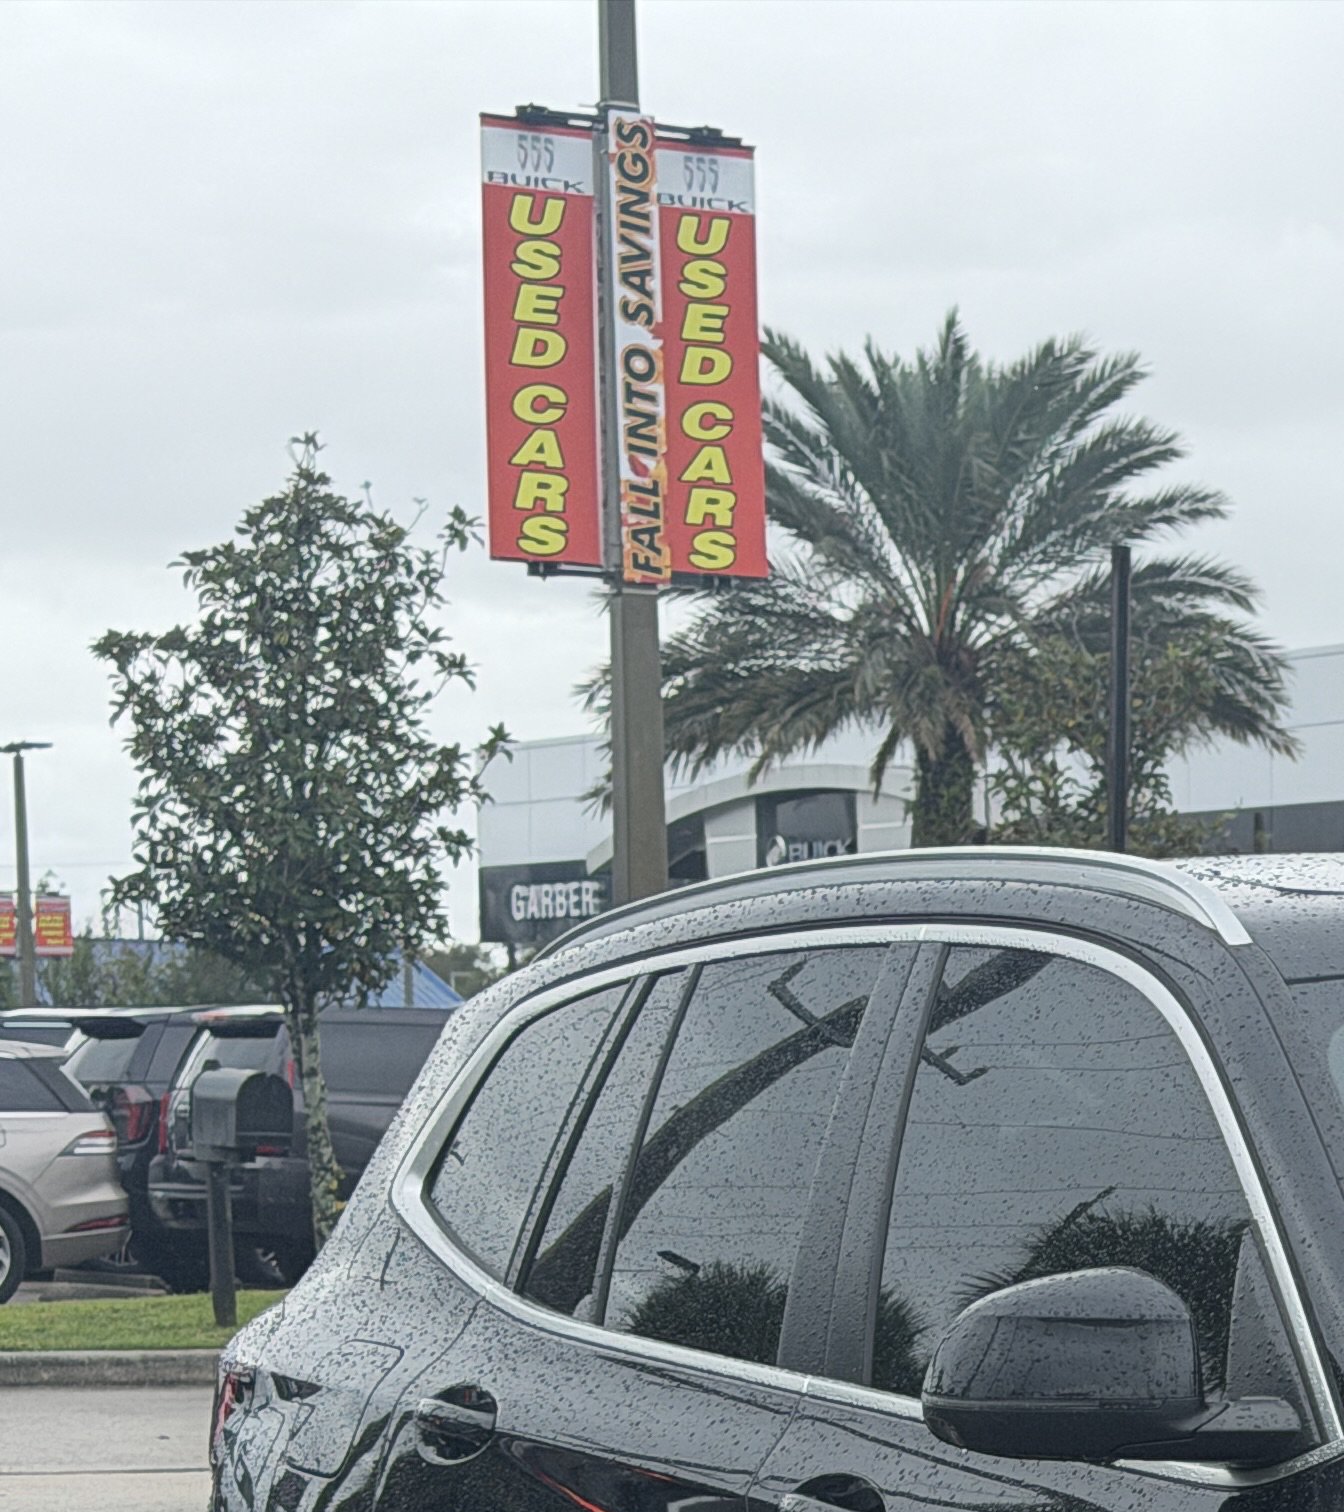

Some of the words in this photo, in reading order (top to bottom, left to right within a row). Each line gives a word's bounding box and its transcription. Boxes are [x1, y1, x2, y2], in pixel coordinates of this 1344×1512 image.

[487, 169, 585, 194] BUICK
[614, 118, 655, 330] SAVINGS
[657, 192, 750, 214] BUICK
[508, 192, 568, 370] USED
[675, 214, 734, 386] USED
[623, 345, 661, 459] INTO
[508, 383, 569, 558] CARS
[678, 401, 738, 572] CARS
[632, 480, 665, 579] FALL
[511, 881, 602, 921] GARBER
[788, 838, 852, 862] BUICK
